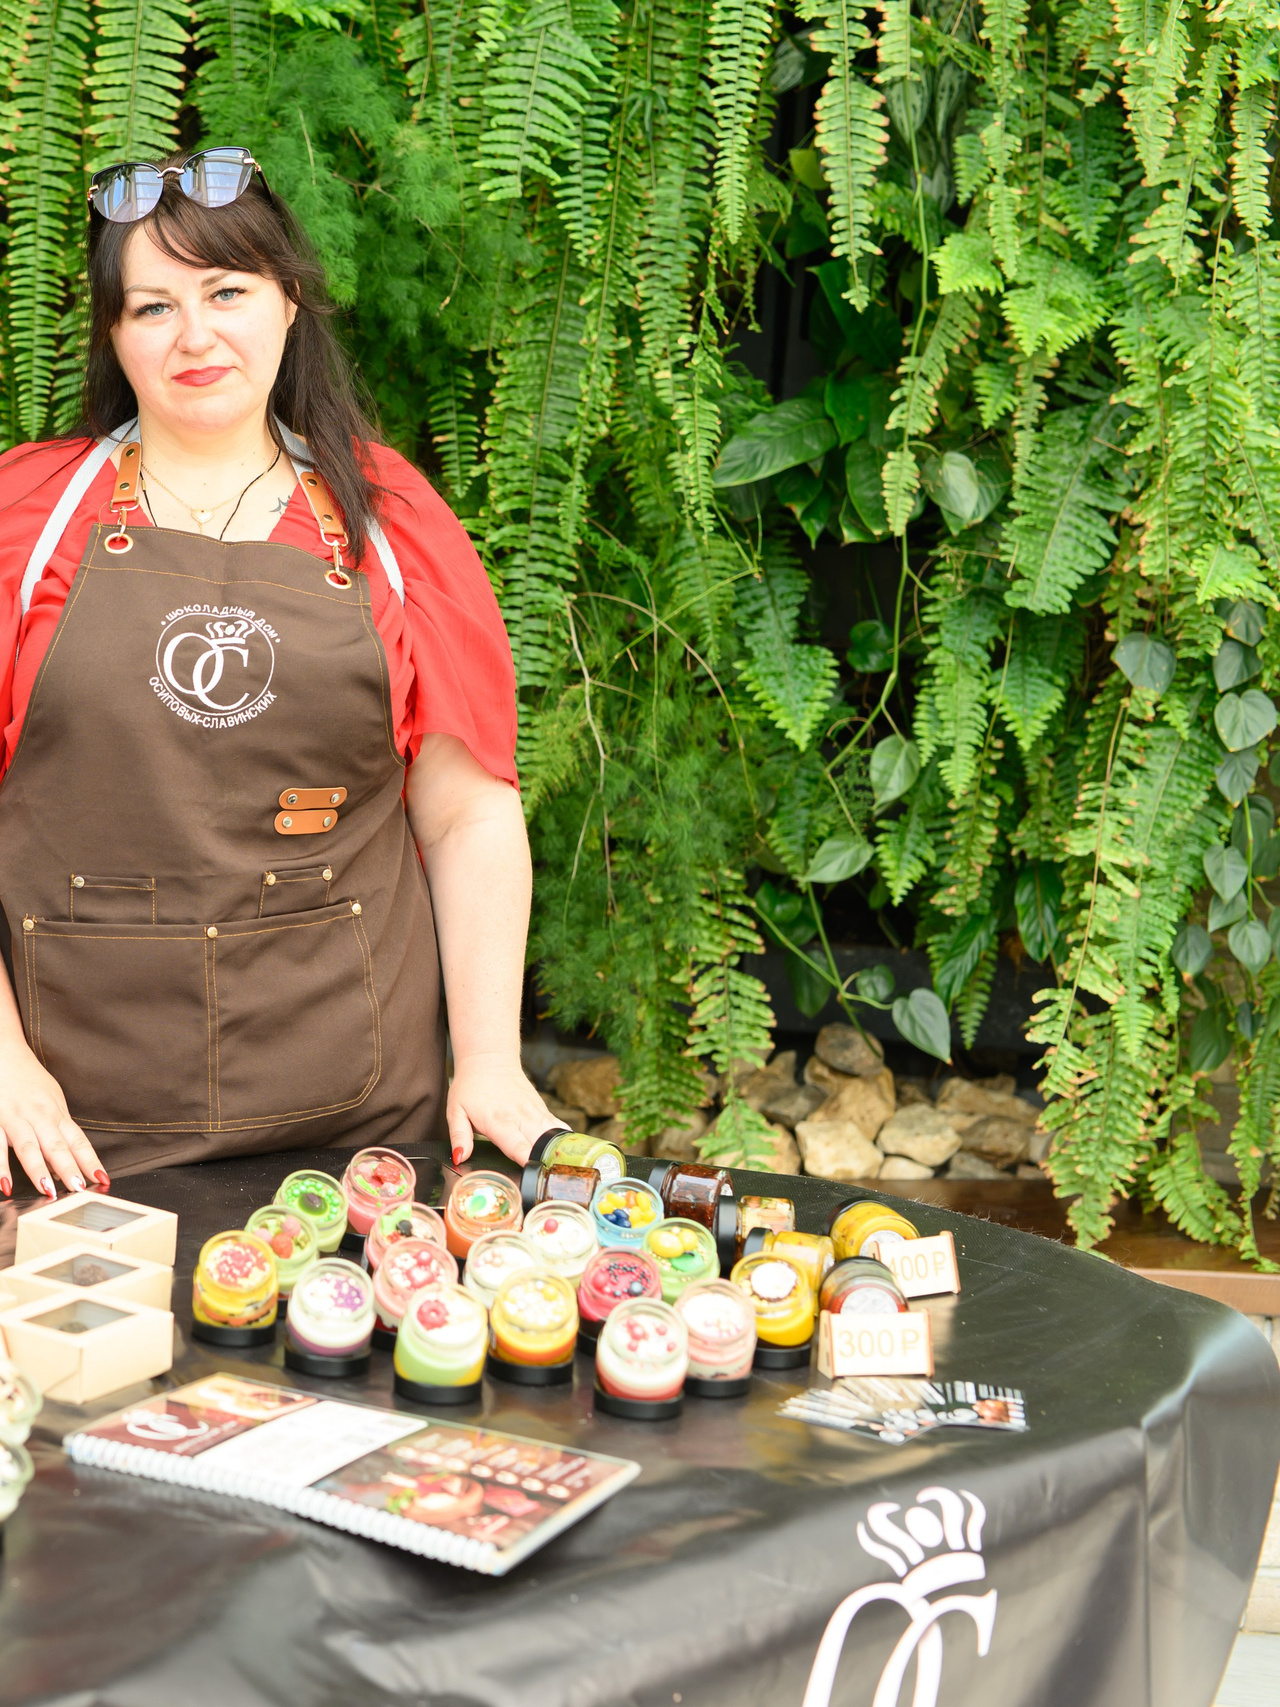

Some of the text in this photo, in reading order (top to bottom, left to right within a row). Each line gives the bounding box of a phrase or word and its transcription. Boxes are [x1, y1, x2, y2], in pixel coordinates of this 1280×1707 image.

[166, 604, 278, 638] ШОКОЛАДНЫЙ ДОМ
[149, 676, 277, 729] ОСИПОВЫХ-СЛАВИНСКИХ
[838, 1329, 894, 1358] 300
